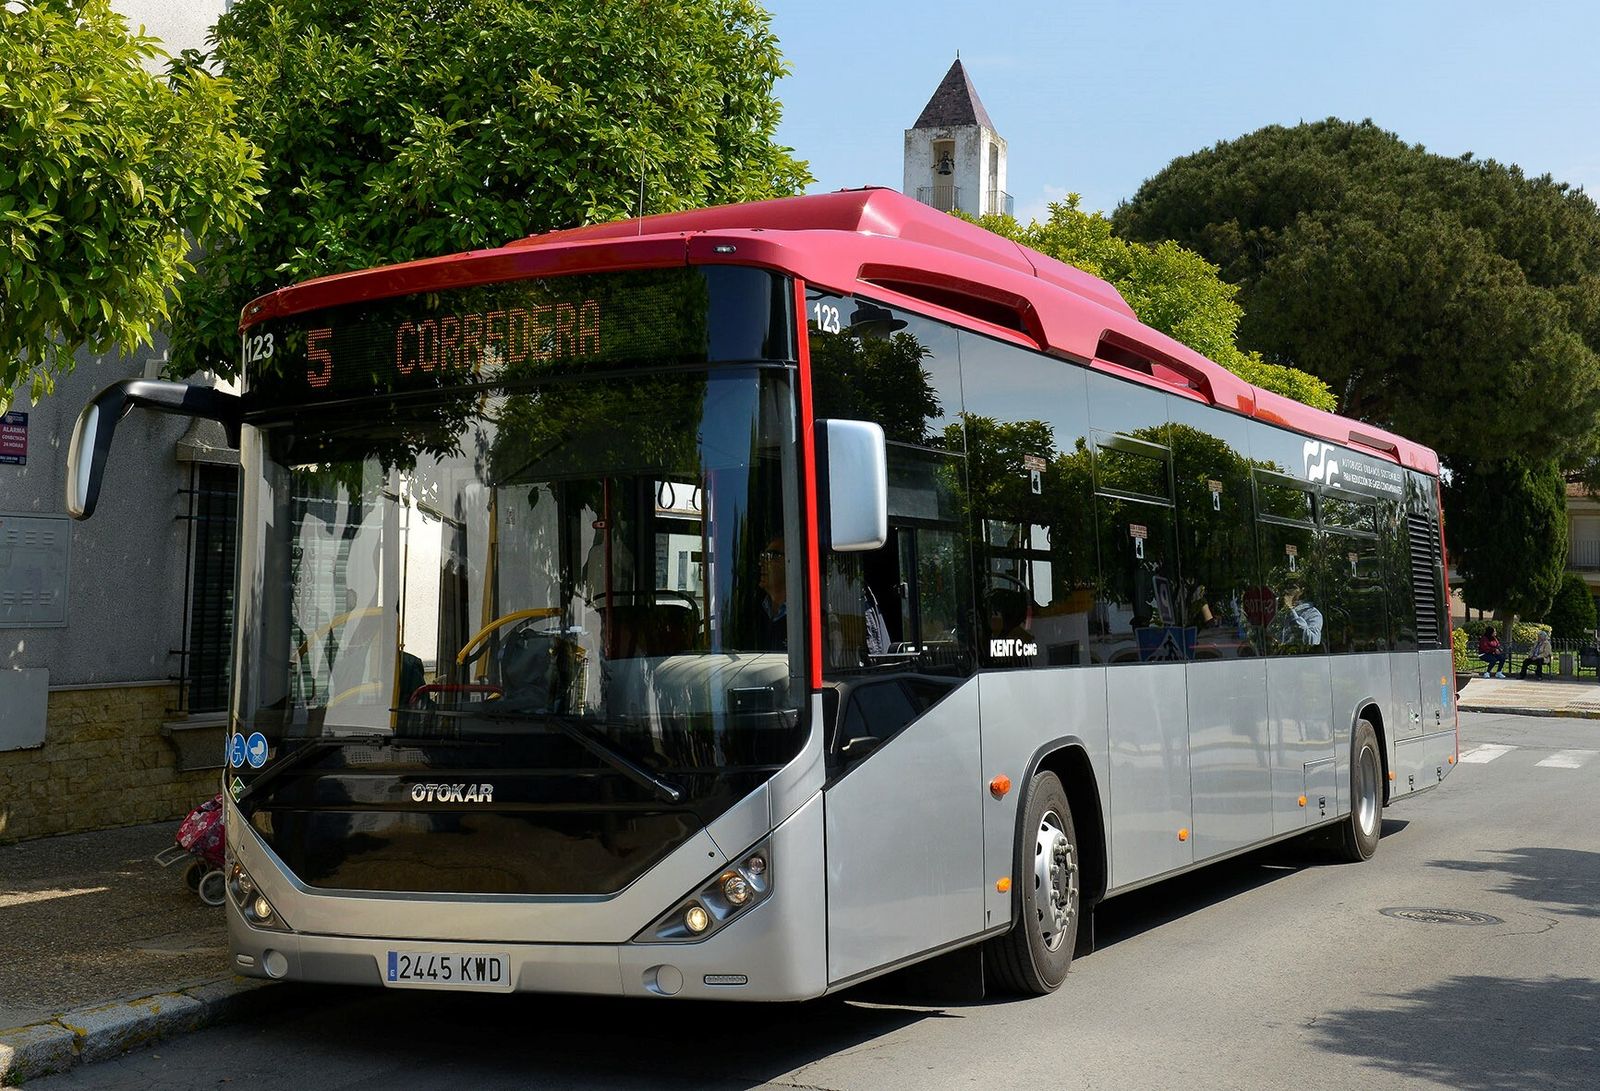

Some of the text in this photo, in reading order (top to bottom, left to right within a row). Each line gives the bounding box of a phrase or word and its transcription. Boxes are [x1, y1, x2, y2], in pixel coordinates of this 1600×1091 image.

[814, 302, 841, 335] 123
[245, 332, 274, 363] 123
[307, 299, 600, 388] 5 CORREDERA
[2, 426, 26, 434] ALARMA
[990, 639, 1015, 658] KENT
[1015, 638, 1023, 657] C
[411, 783, 494, 803] OTOKAR
[399, 955, 452, 980] 2445
[460, 956, 501, 982] KWD
